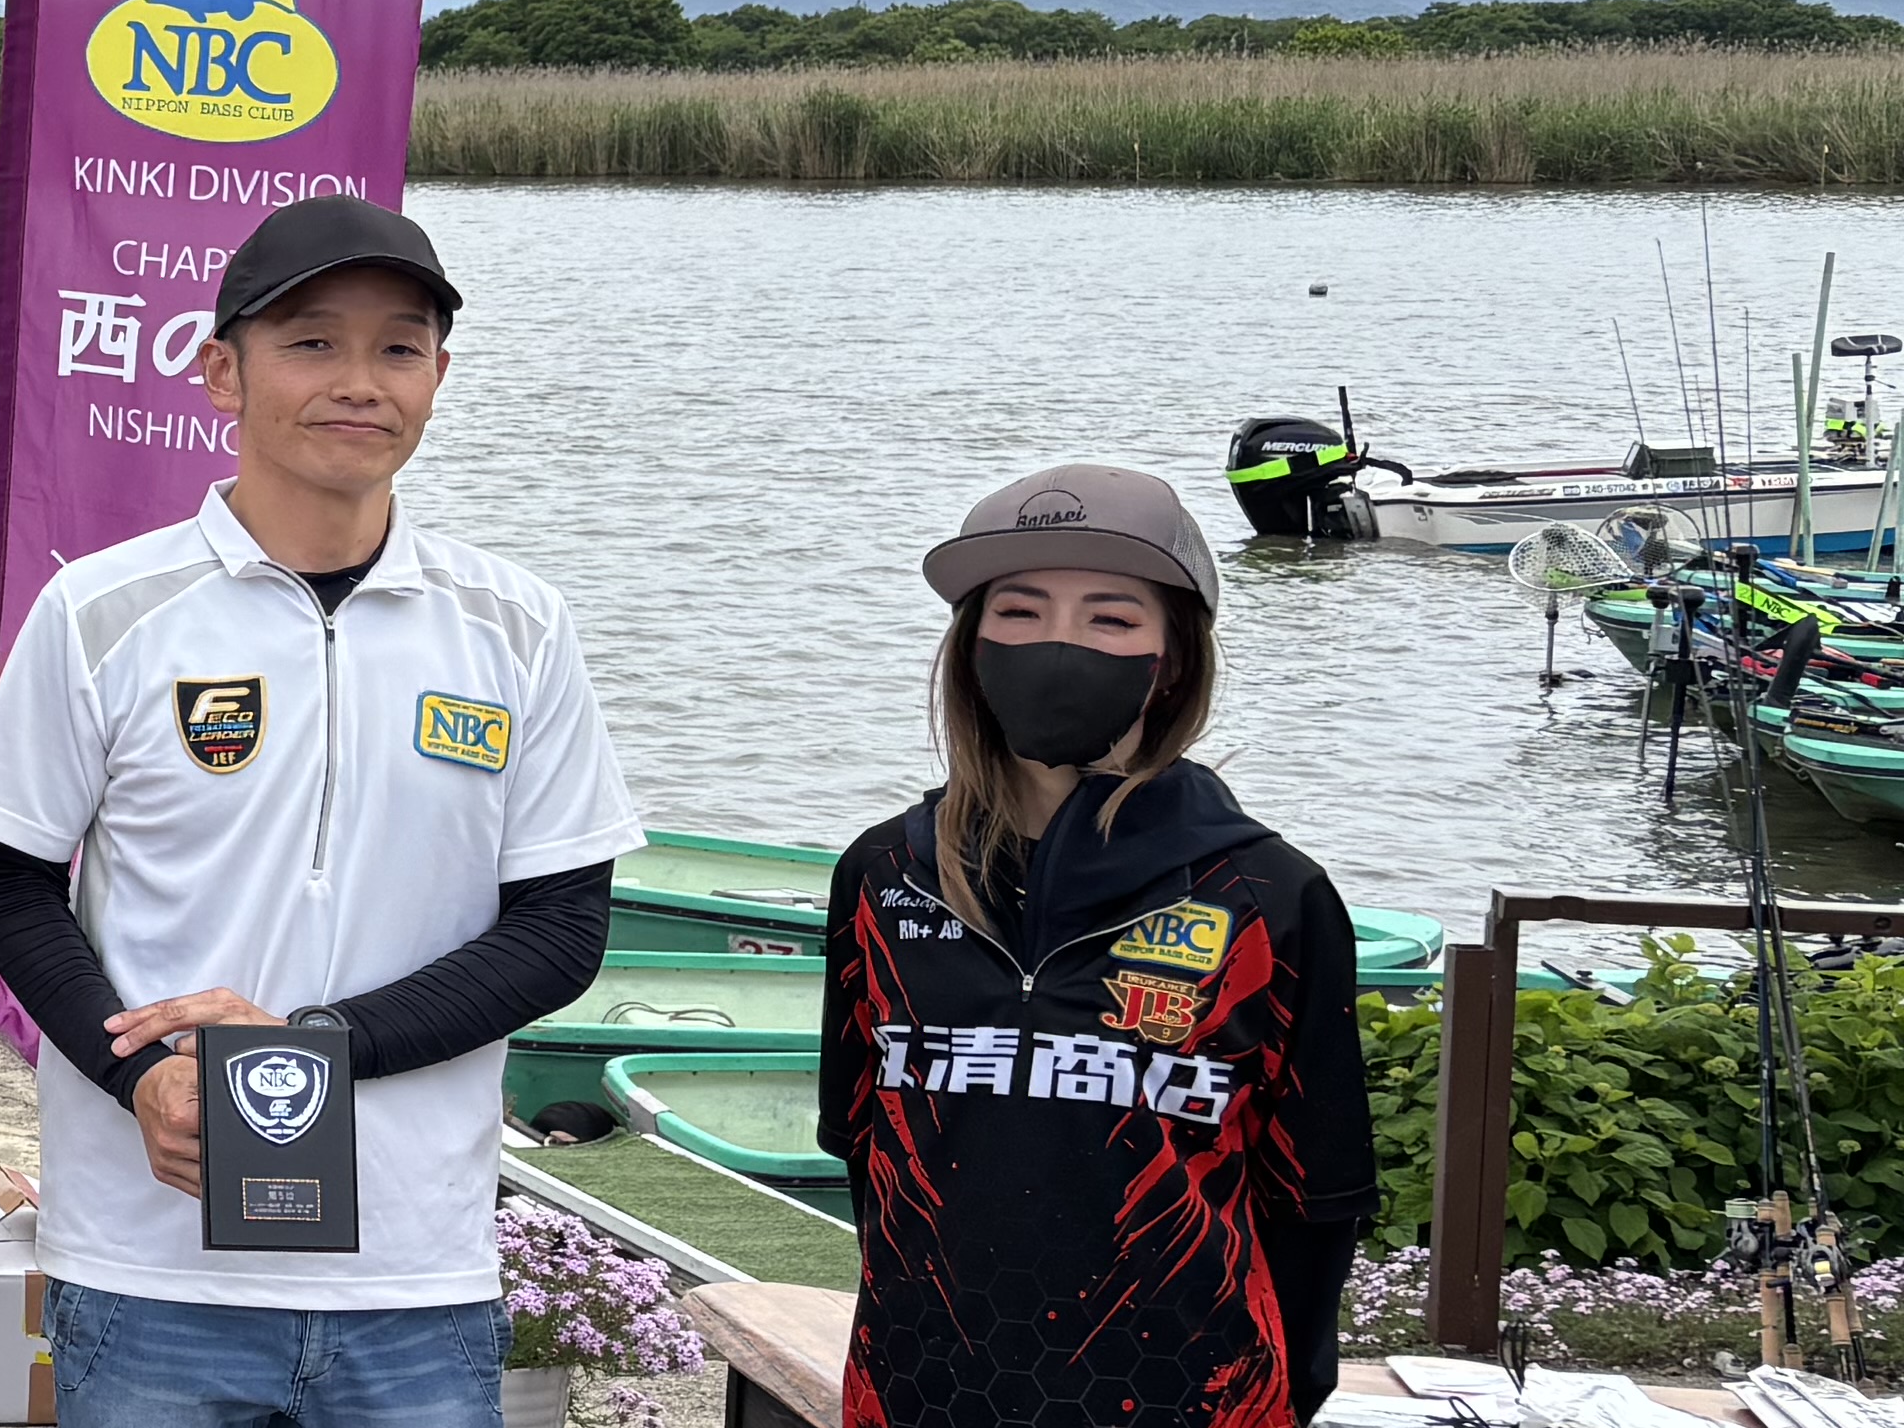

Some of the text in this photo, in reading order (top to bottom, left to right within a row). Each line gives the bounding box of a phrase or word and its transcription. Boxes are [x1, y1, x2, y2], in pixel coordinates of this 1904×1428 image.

[122, 21, 292, 104] NBC
[122, 97, 295, 122] NIPPON BASS CLUB
[74, 156, 367, 209] KINKI DIVISION
[112, 239, 238, 283] CHAP
[1760, 596, 1792, 619] NBC
[428, 706, 503, 755] NBC
[211, 752, 236, 765] JEF
[899, 919, 964, 940] Rh+ AB
[1121, 913, 1217, 955] NBC
[1101, 983, 1196, 1030] JB
[260, 1071, 297, 1088] NBC
